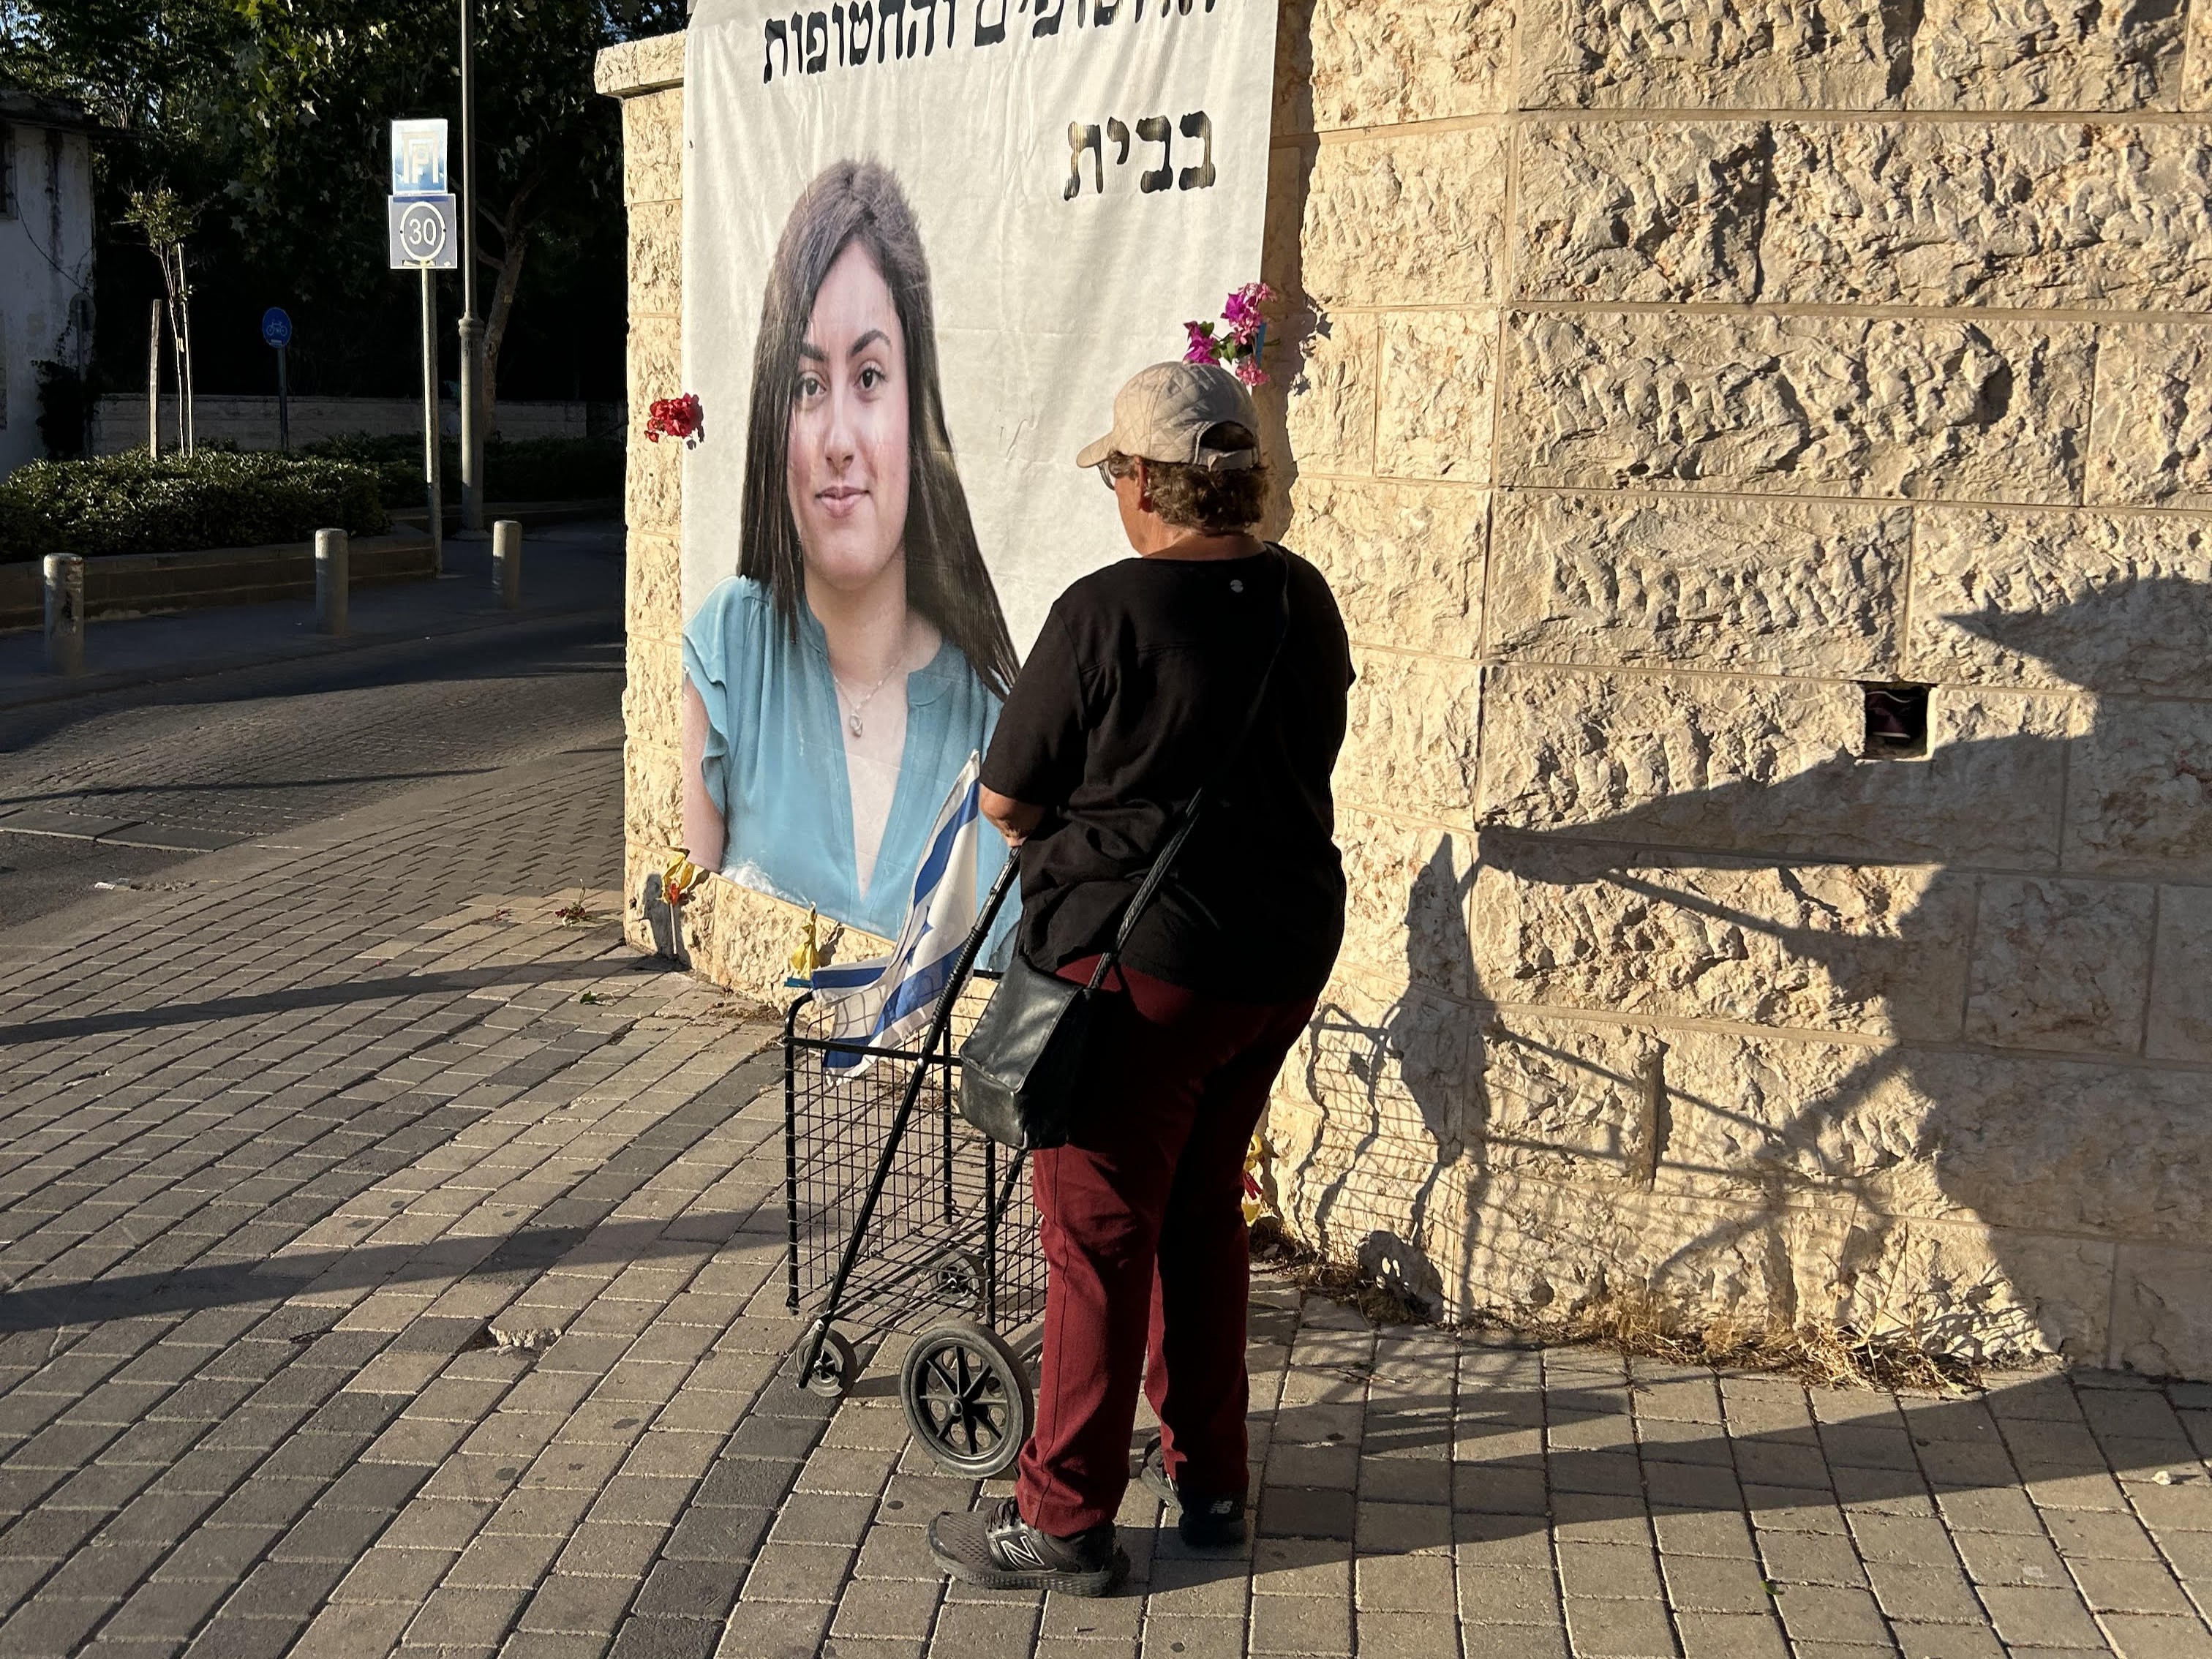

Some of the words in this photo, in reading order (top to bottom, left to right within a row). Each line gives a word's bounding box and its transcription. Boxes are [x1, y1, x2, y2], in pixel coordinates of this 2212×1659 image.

[764, 0, 955, 84] והחטופות
[1064, 110, 1216, 201] בבית
[409, 218, 437, 247] 30
[1000, 1536, 1045, 1567] N
